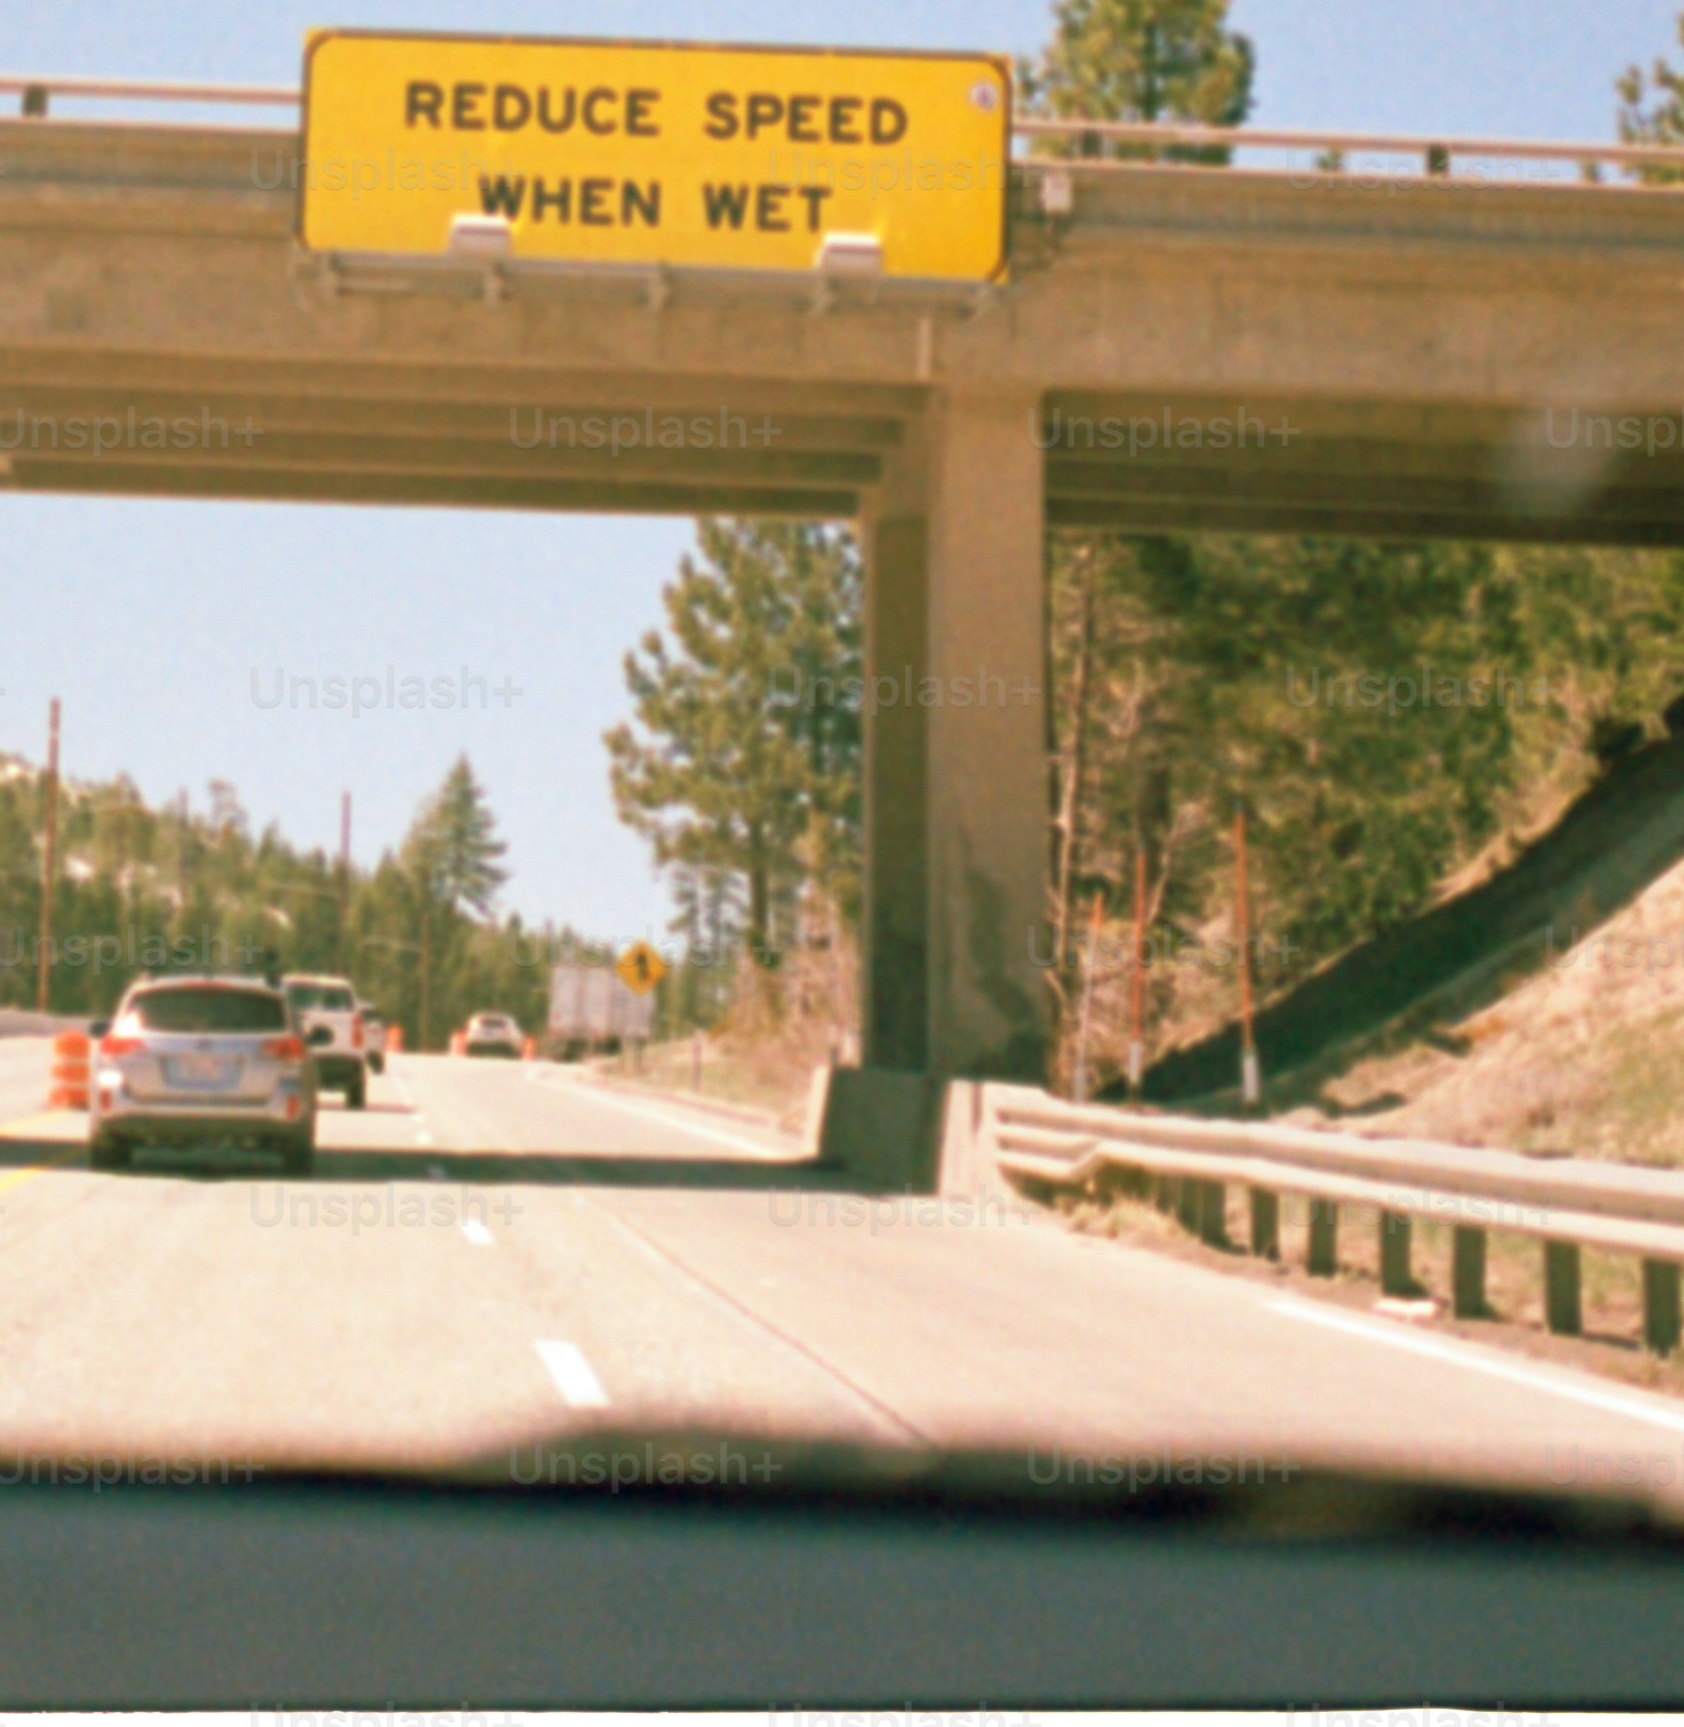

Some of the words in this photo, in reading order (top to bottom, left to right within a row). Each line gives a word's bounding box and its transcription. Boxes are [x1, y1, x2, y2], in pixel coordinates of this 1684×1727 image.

[405, 81, 661, 138] REDUCE
[702, 91, 909, 146] SPEED
[478, 173, 662, 228] WHEN
[702, 182, 833, 233] WET
